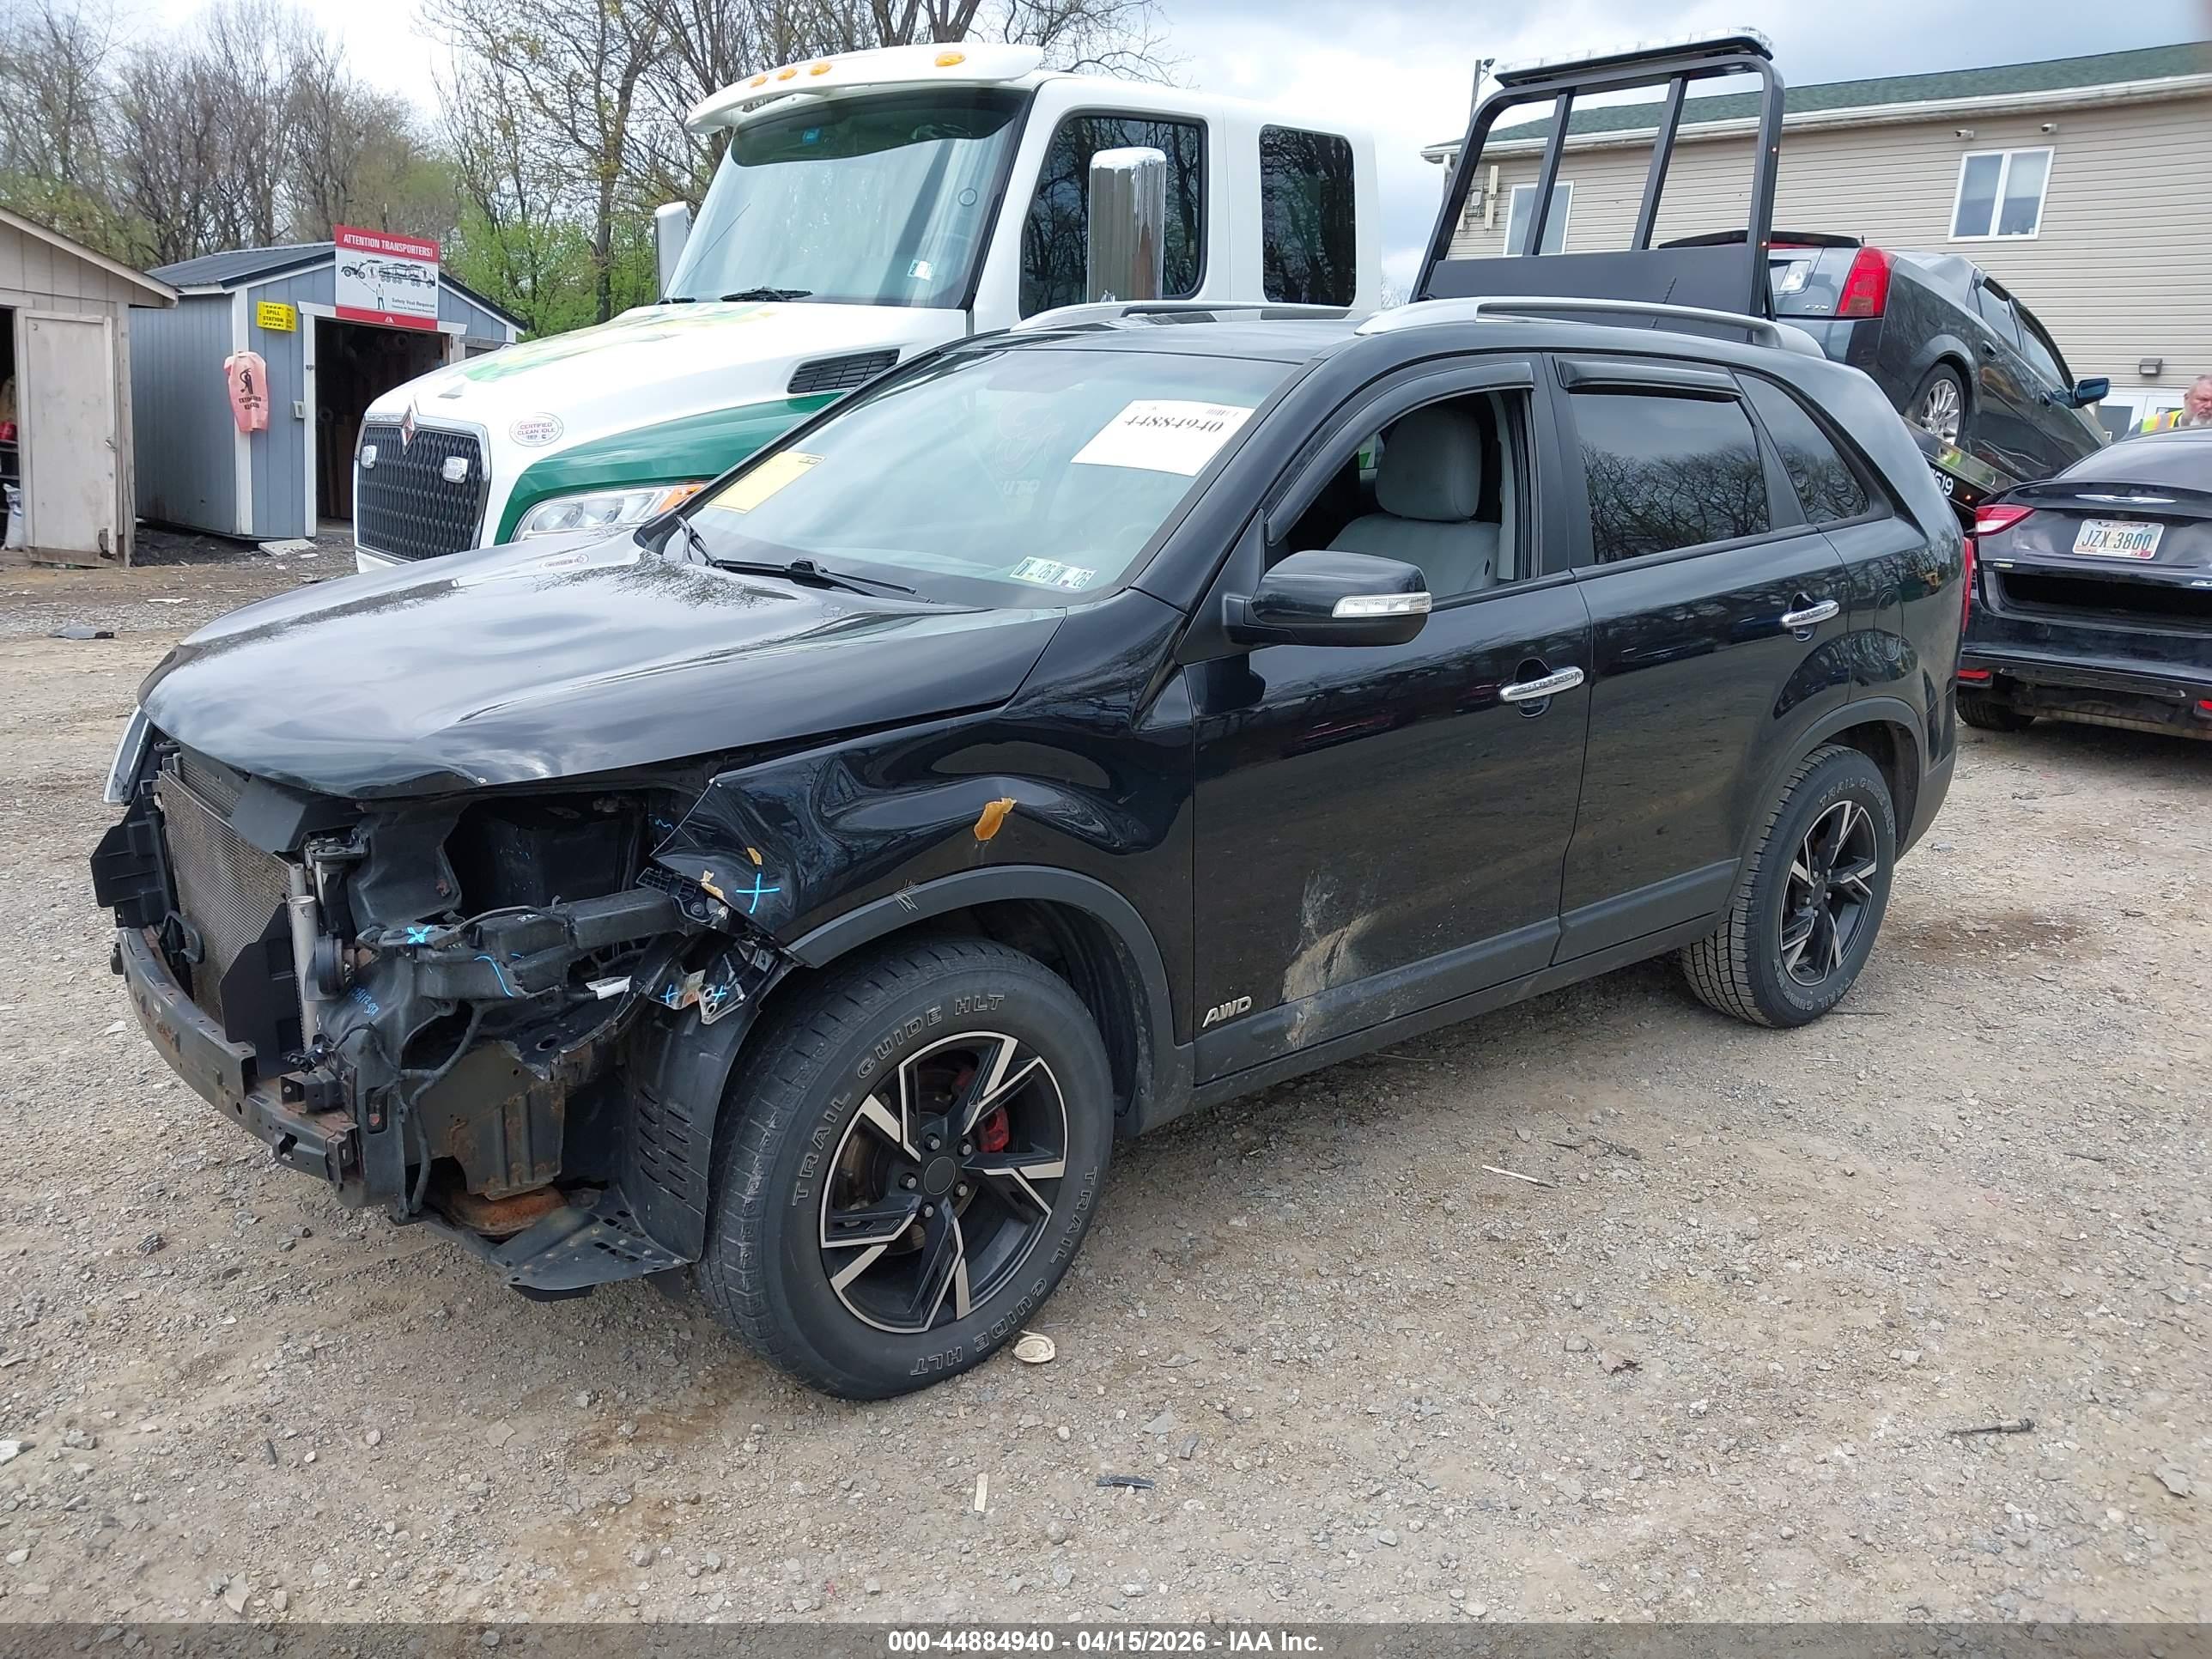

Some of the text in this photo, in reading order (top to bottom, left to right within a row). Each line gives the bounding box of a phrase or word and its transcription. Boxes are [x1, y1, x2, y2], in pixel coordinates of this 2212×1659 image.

[343, 234, 434, 257] ATTENTION TRANSPORTERS!
[1124, 415, 1224, 433] 44884940
[2081, 529, 2153, 551] JZX 3800
[1202, 996, 1252, 1028] AWD
[792, 994, 1005, 1206] TRAIL GUIDE HLT
[910, 1166, 1099, 1376] TRAIL GUIDE HLT
